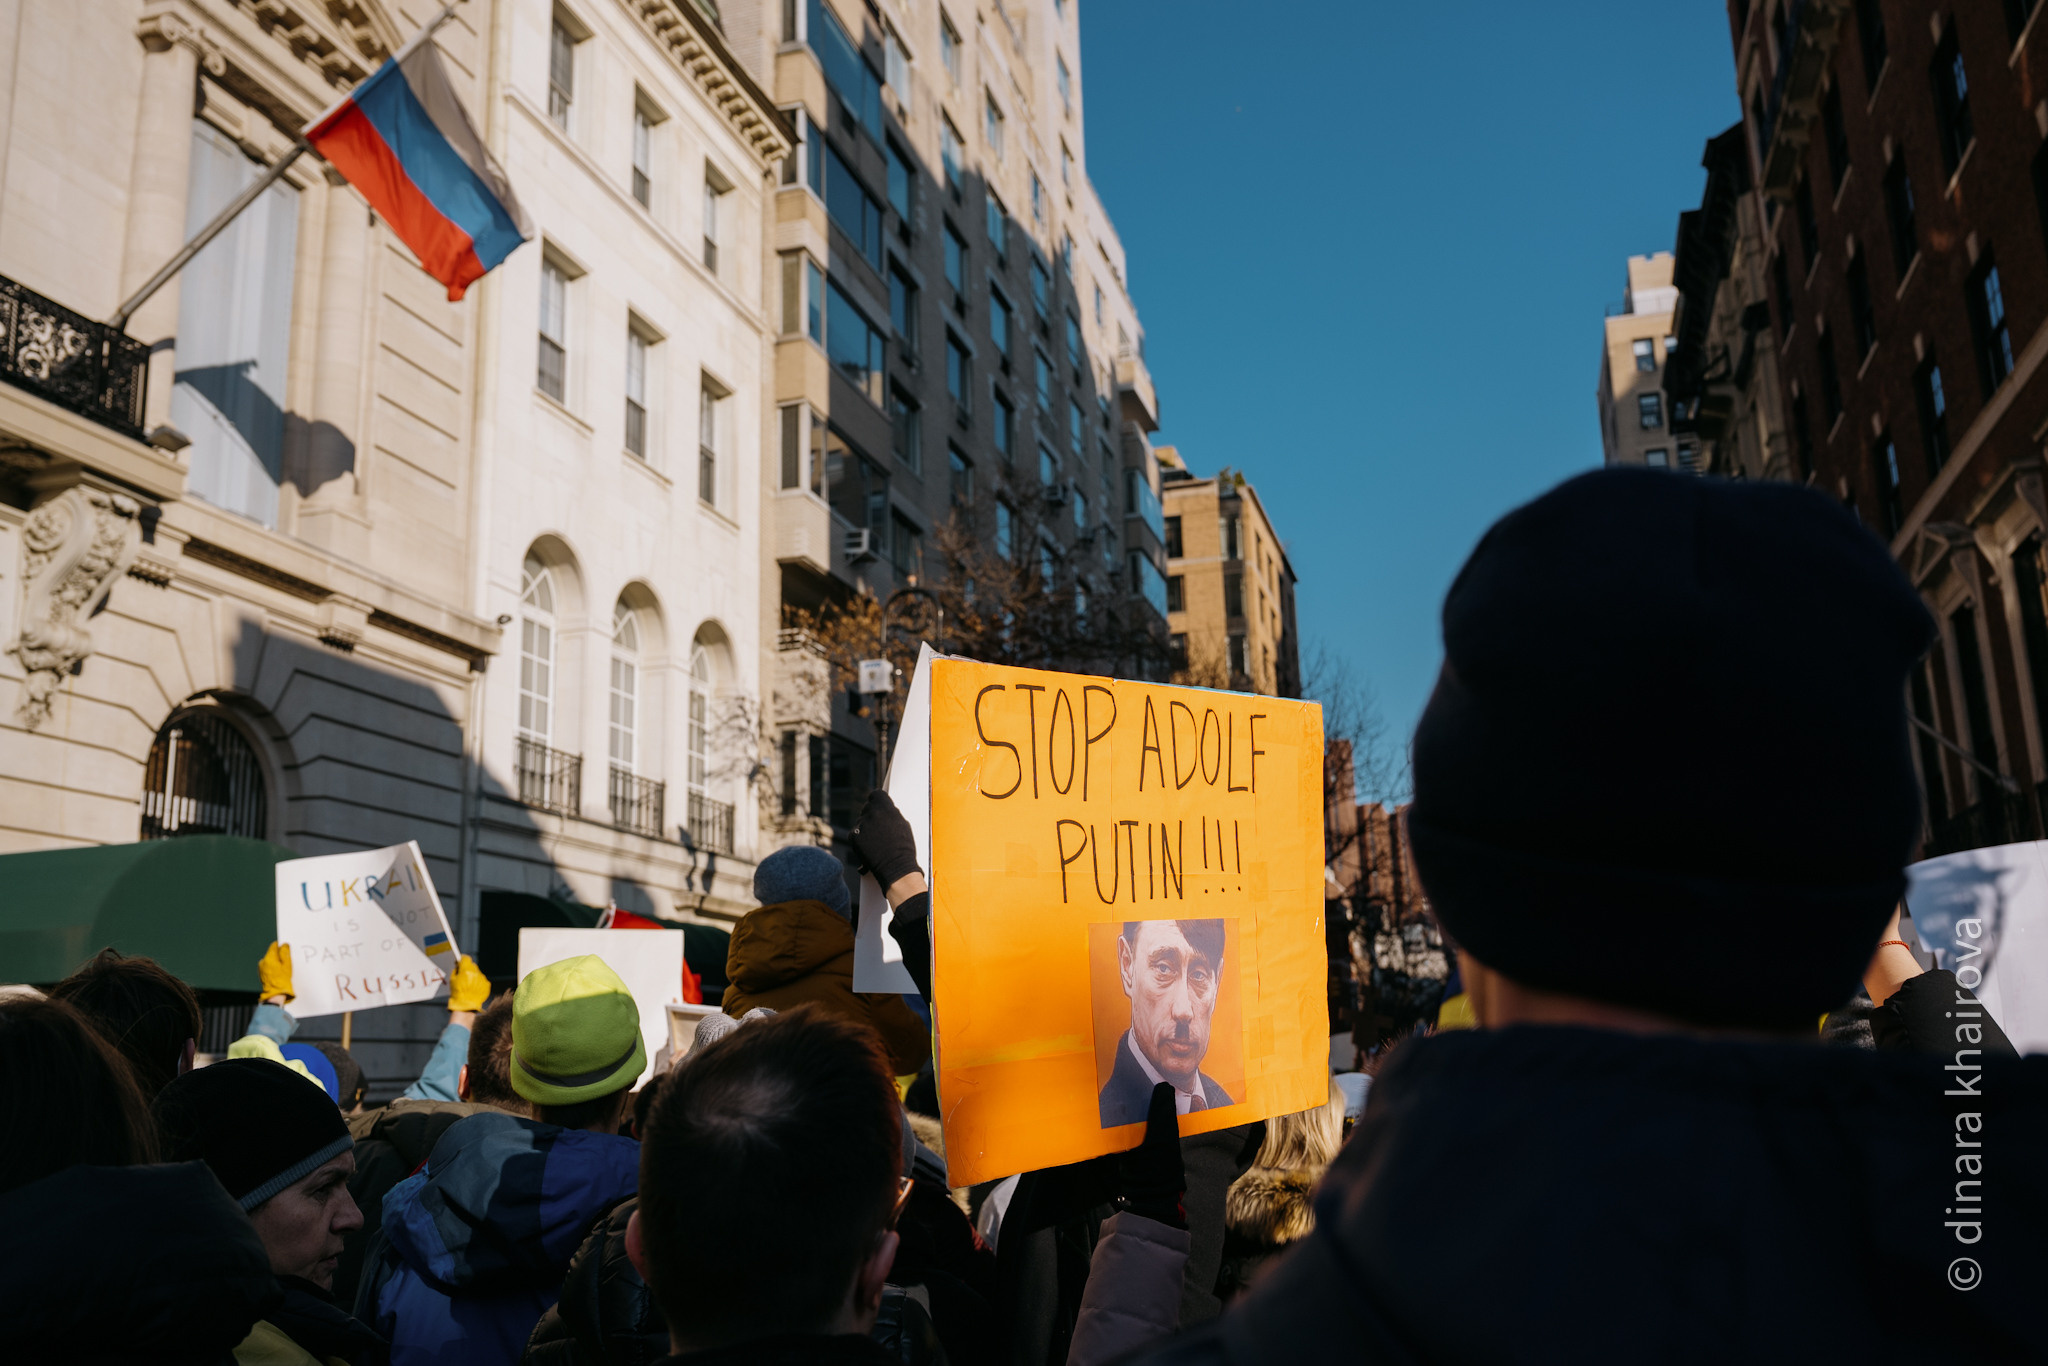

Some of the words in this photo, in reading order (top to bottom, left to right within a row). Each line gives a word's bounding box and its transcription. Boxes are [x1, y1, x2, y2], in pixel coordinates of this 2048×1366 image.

[975, 684, 1117, 801] STOP
[1139, 694, 1267, 793] ADOLF
[1056, 815, 1242, 904] PUTIN!!!
[332, 919, 360, 932] IS
[390, 906, 431, 926] NOT
[301, 942, 363, 963] PART
[380, 937, 406, 952] OF
